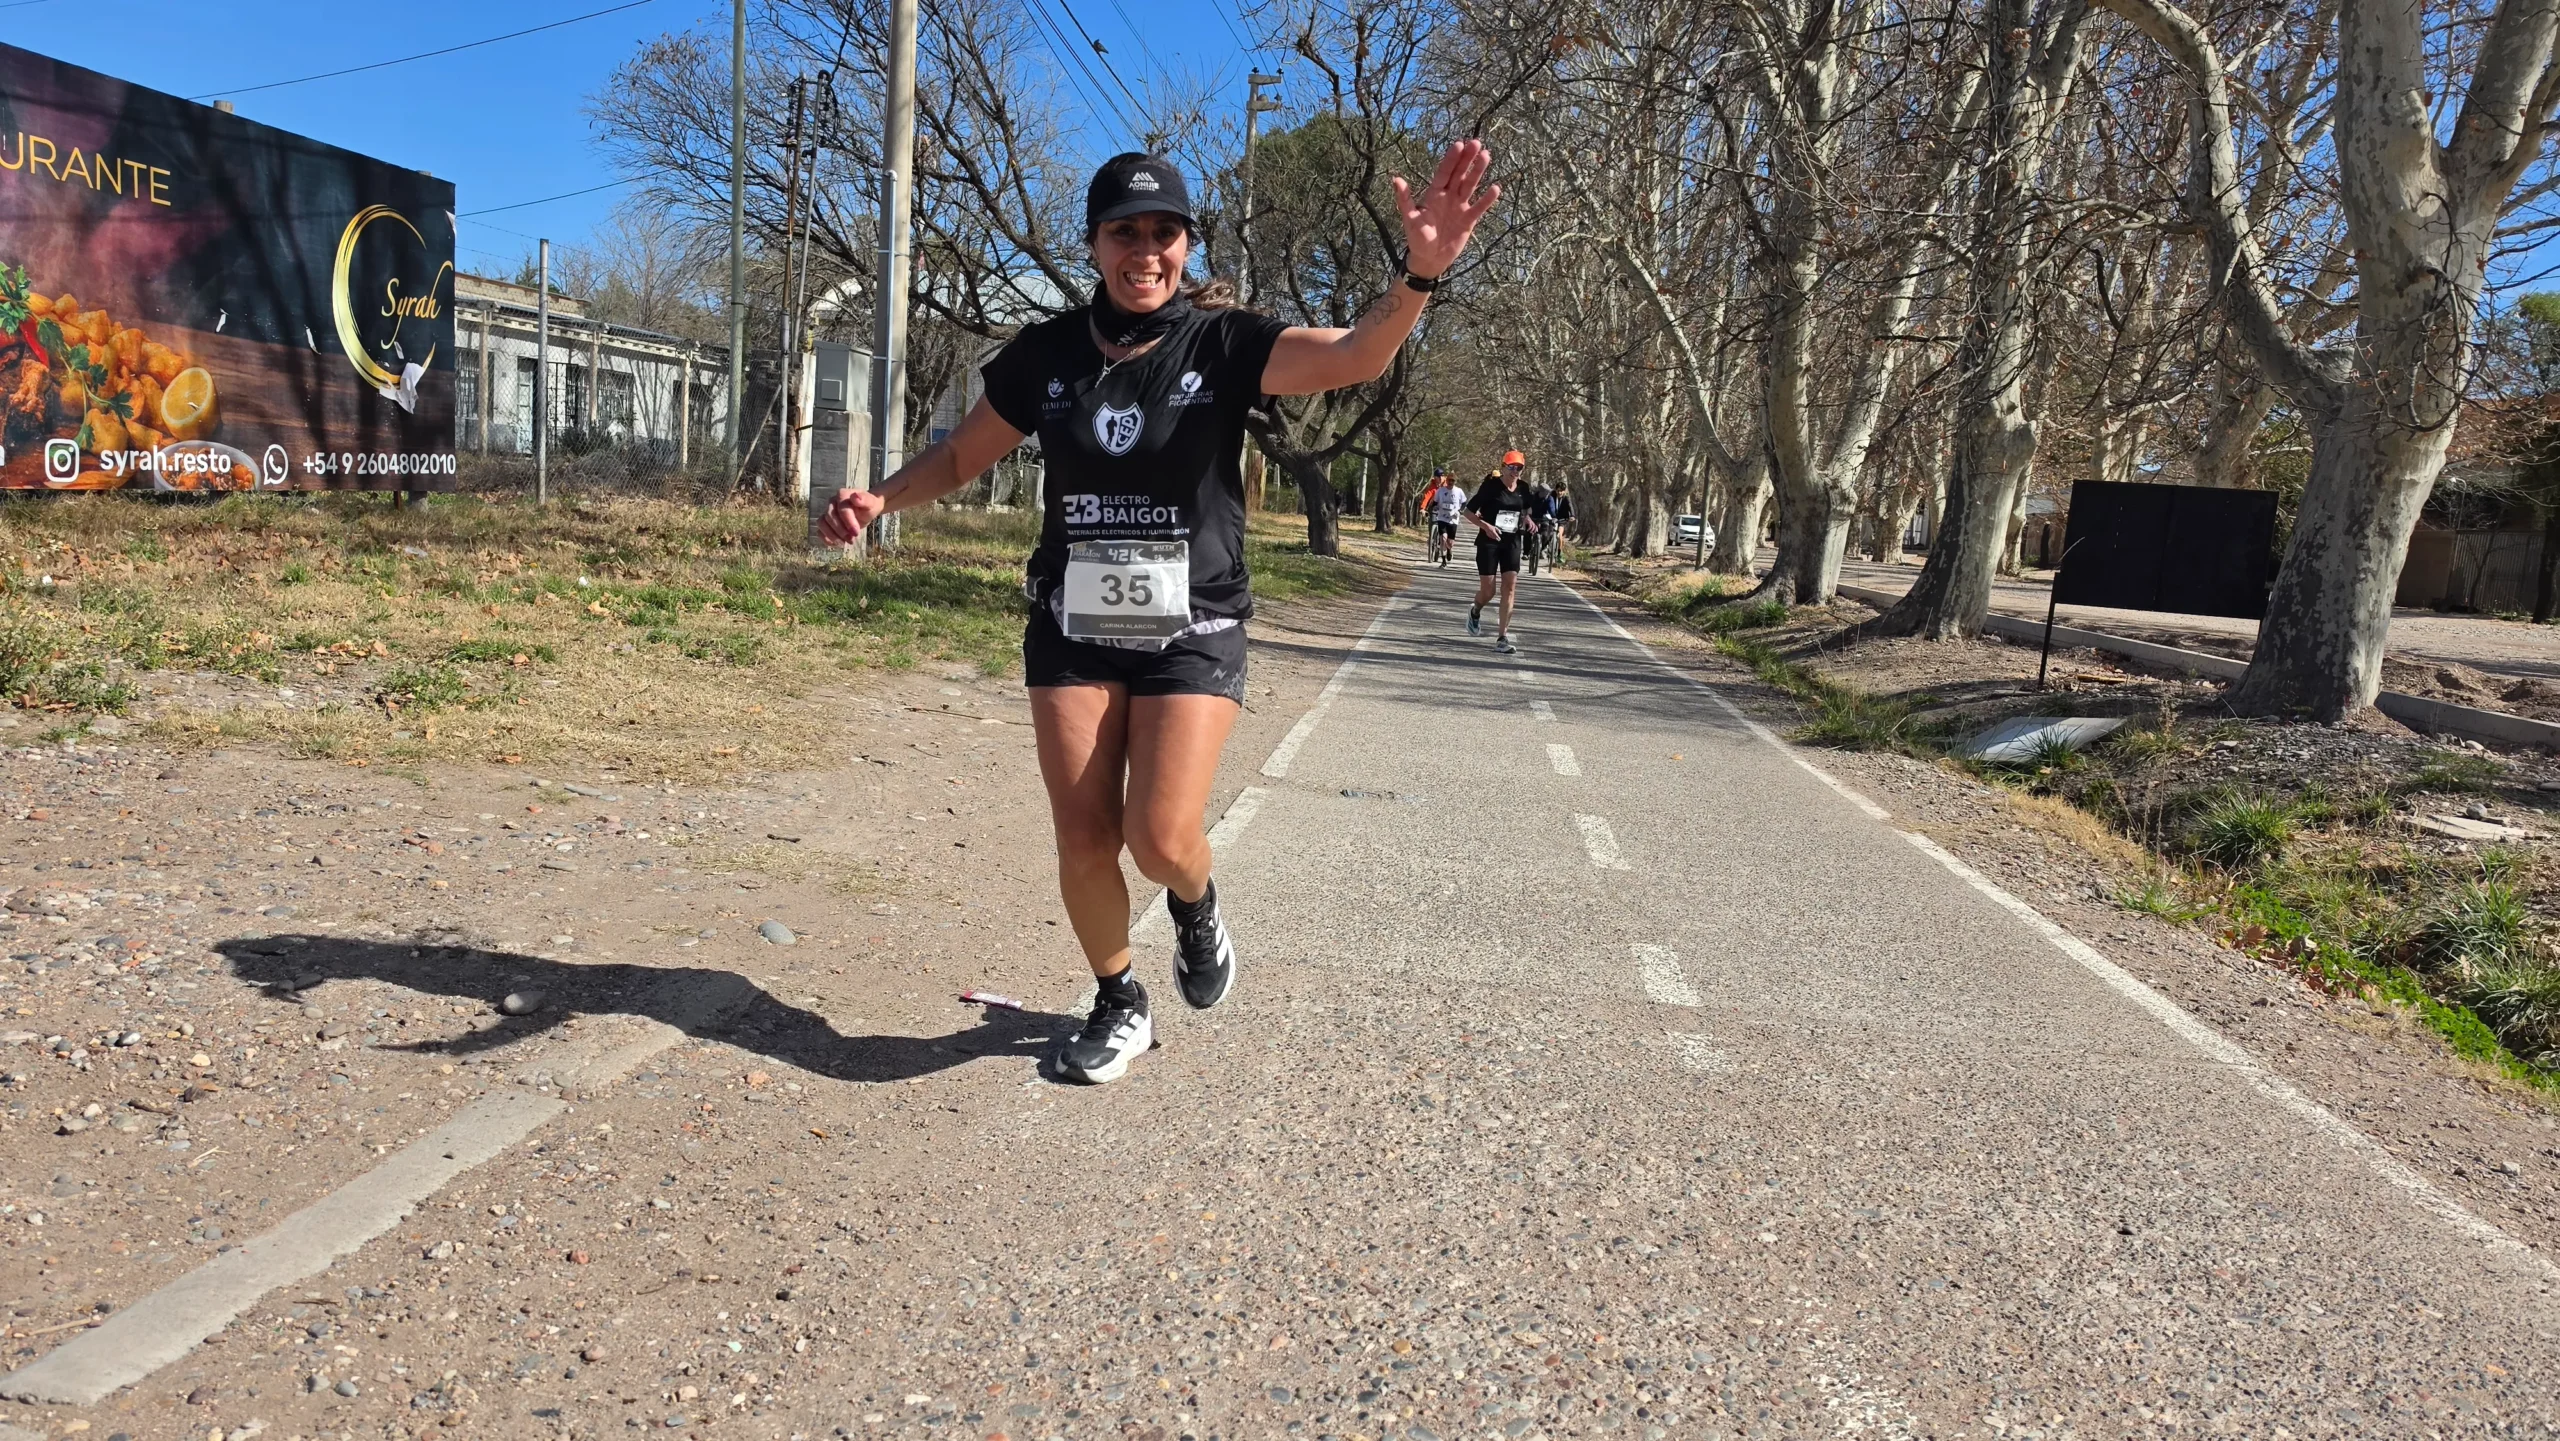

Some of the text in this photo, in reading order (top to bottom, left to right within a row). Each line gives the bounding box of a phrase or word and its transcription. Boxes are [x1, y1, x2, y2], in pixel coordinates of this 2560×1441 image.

[0, 131, 172, 206] URANTE
[381, 260, 454, 349] Syrah
[1168, 396, 1214, 408] FIORENTINO
[1117, 416, 1136, 445] CEP
[100, 445, 231, 477] syrah.resto
[303, 451, 457, 475] +54 9 2604802010
[1102, 495, 1151, 505] ELECTRO
[1102, 506, 1179, 524] BAIGOT
[1107, 548, 1144, 562] 42K
[1100, 574, 1153, 607] 35
